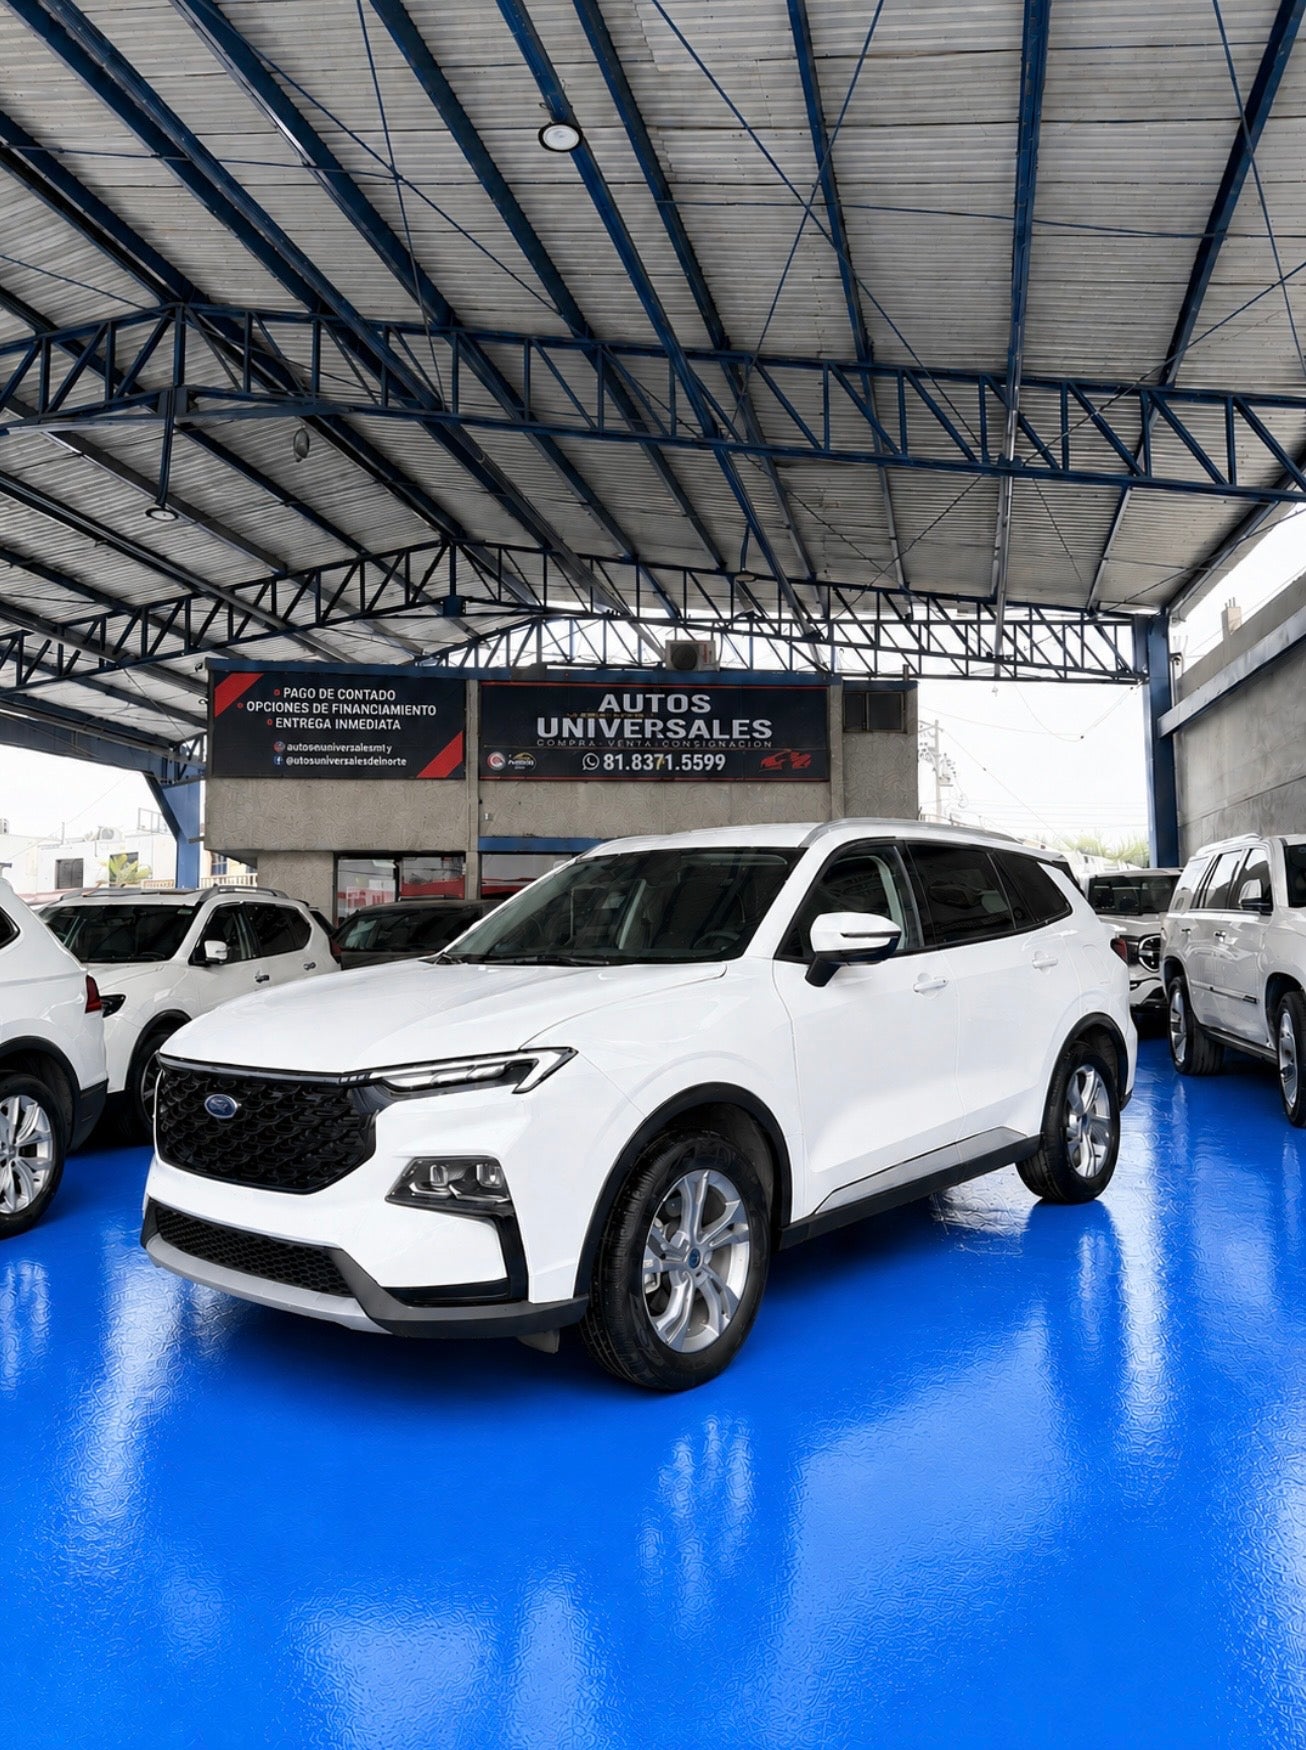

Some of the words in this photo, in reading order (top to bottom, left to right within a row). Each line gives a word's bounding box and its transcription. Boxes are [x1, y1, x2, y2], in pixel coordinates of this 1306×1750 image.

[283, 687, 316, 699] PAGO
[319, 688, 335, 700] DE
[337, 688, 396, 701] CONTADO
[246, 701, 309, 714] OPCIONES
[312, 703, 329, 714] DE
[332, 703, 437, 717] FINANCIAMIENTO
[598, 693, 712, 714] AUTOS
[275, 718, 332, 730] ENTREGA
[335, 719, 401, 731] INMEDIATA
[536, 717, 773, 740] UNIVERSALES
[537, 739, 596, 748] COMPRA
[608, 740, 651, 748] VENTA
[603, 753, 726, 772] 81.8371.5599
